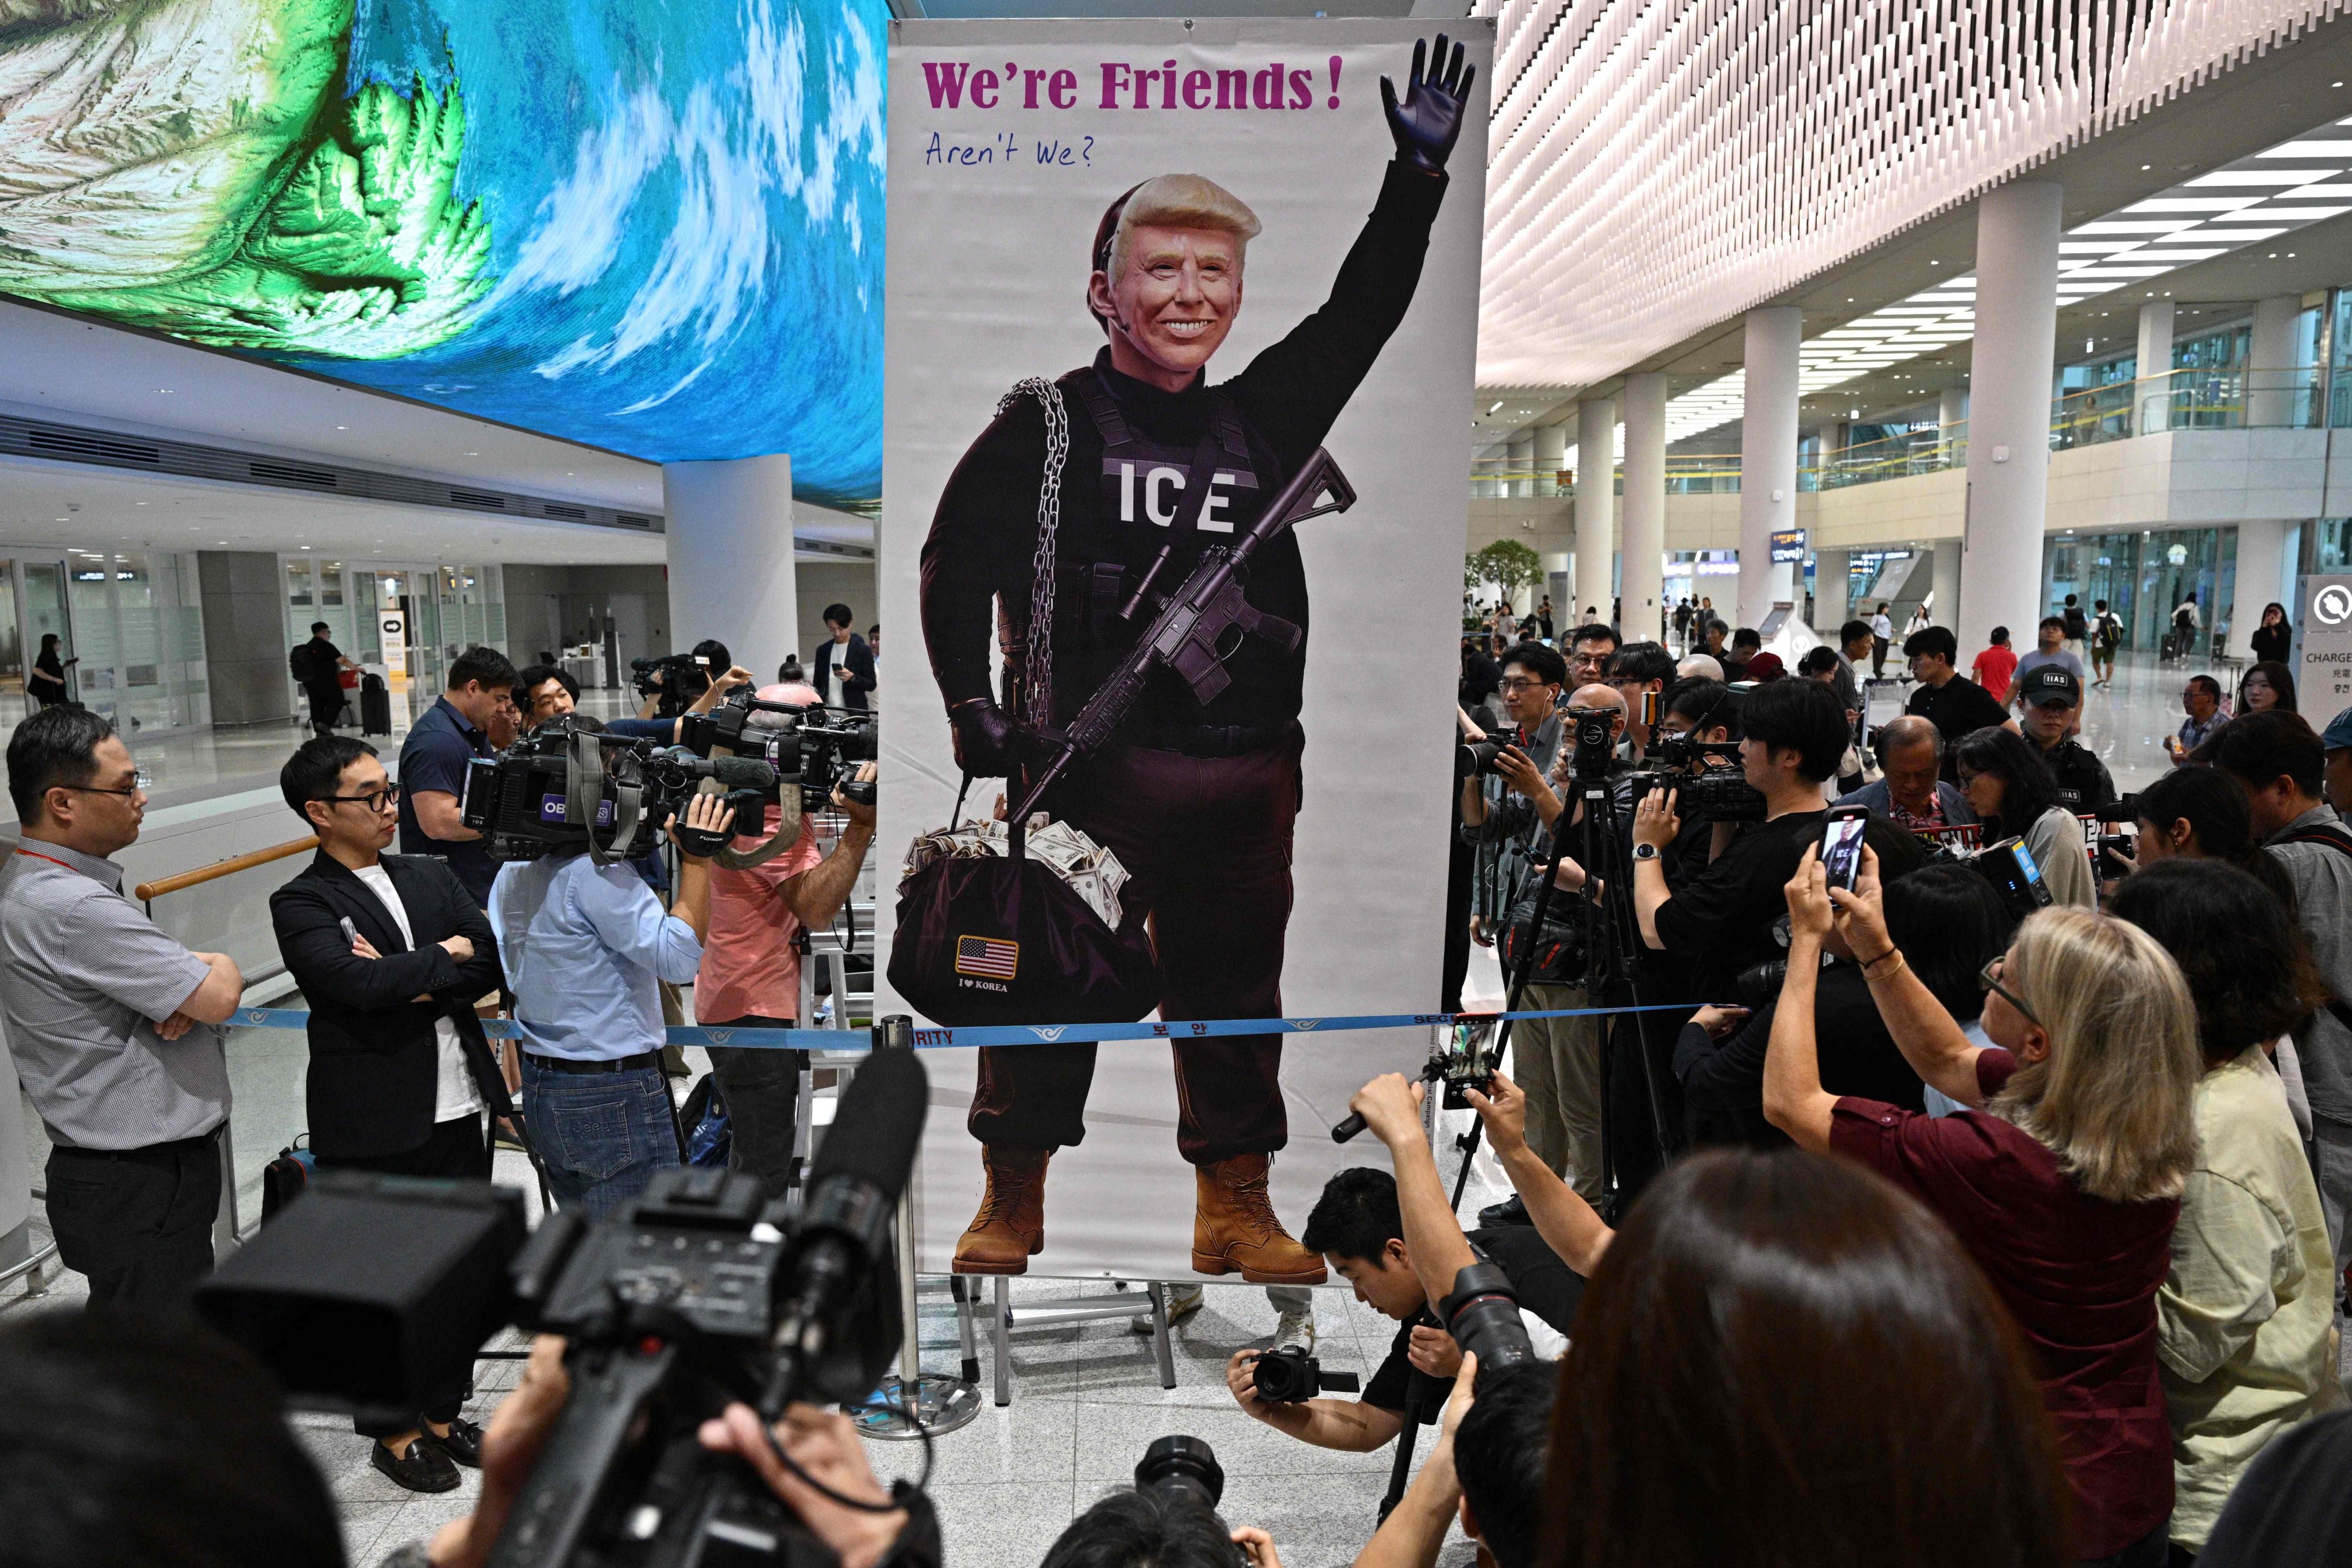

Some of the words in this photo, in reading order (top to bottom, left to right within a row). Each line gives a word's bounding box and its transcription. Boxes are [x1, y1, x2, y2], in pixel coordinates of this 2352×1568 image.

[922, 61, 1077, 110] We’re
[926, 132, 1018, 166] Aren't
[1037, 136, 1094, 167] We?
[1121, 463, 1235, 534] ICE
[2047, 675, 2065, 683] IIAS
[2334, 683, 2350, 693] 충전
[975, 980, 1007, 992] KOREA
[913, 1030, 952, 1045] RITY
[1424, 1096, 1432, 1128] Campaign
[572, 1121, 609, 1134] Jeep
